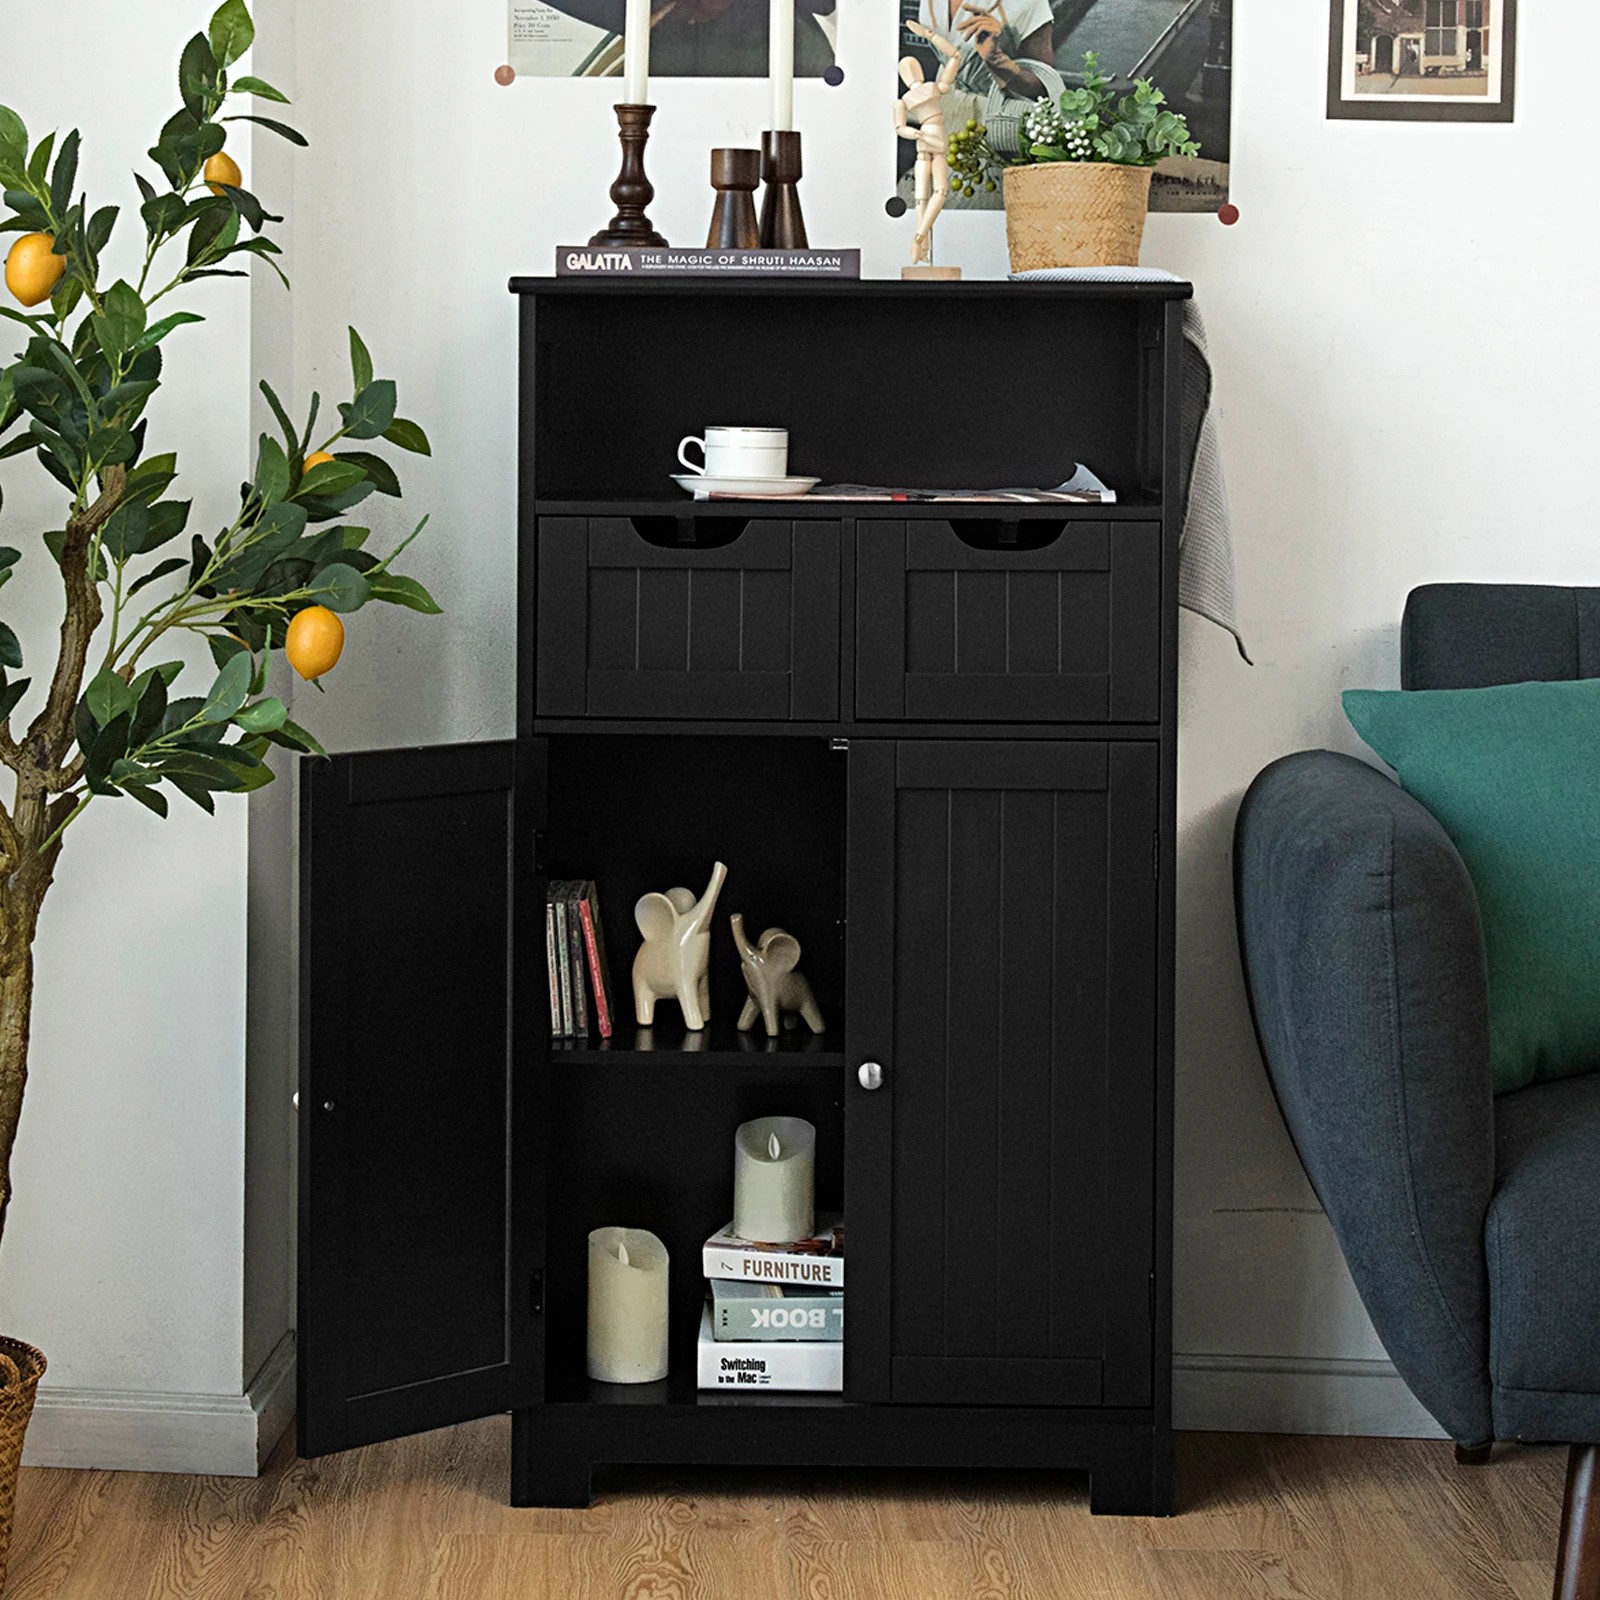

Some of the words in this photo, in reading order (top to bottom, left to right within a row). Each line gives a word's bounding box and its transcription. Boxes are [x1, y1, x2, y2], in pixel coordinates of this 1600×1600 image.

[566, 253, 632, 270] GALATTA
[641, 255, 662, 264] THE
[668, 255, 712, 264] MAGIC
[718, 256, 735, 265] OF
[741, 256, 784, 265] SHRUTI
[789, 257, 840, 266] HAASAN
[743, 1259, 831, 1281] FURNITURE
[751, 1308, 826, 1328] BOOK
[721, 1357, 766, 1373] Switching
[718, 1375, 724, 1383] to
[726, 1375, 735, 1383] the
[737, 1372, 757, 1384] Mac
